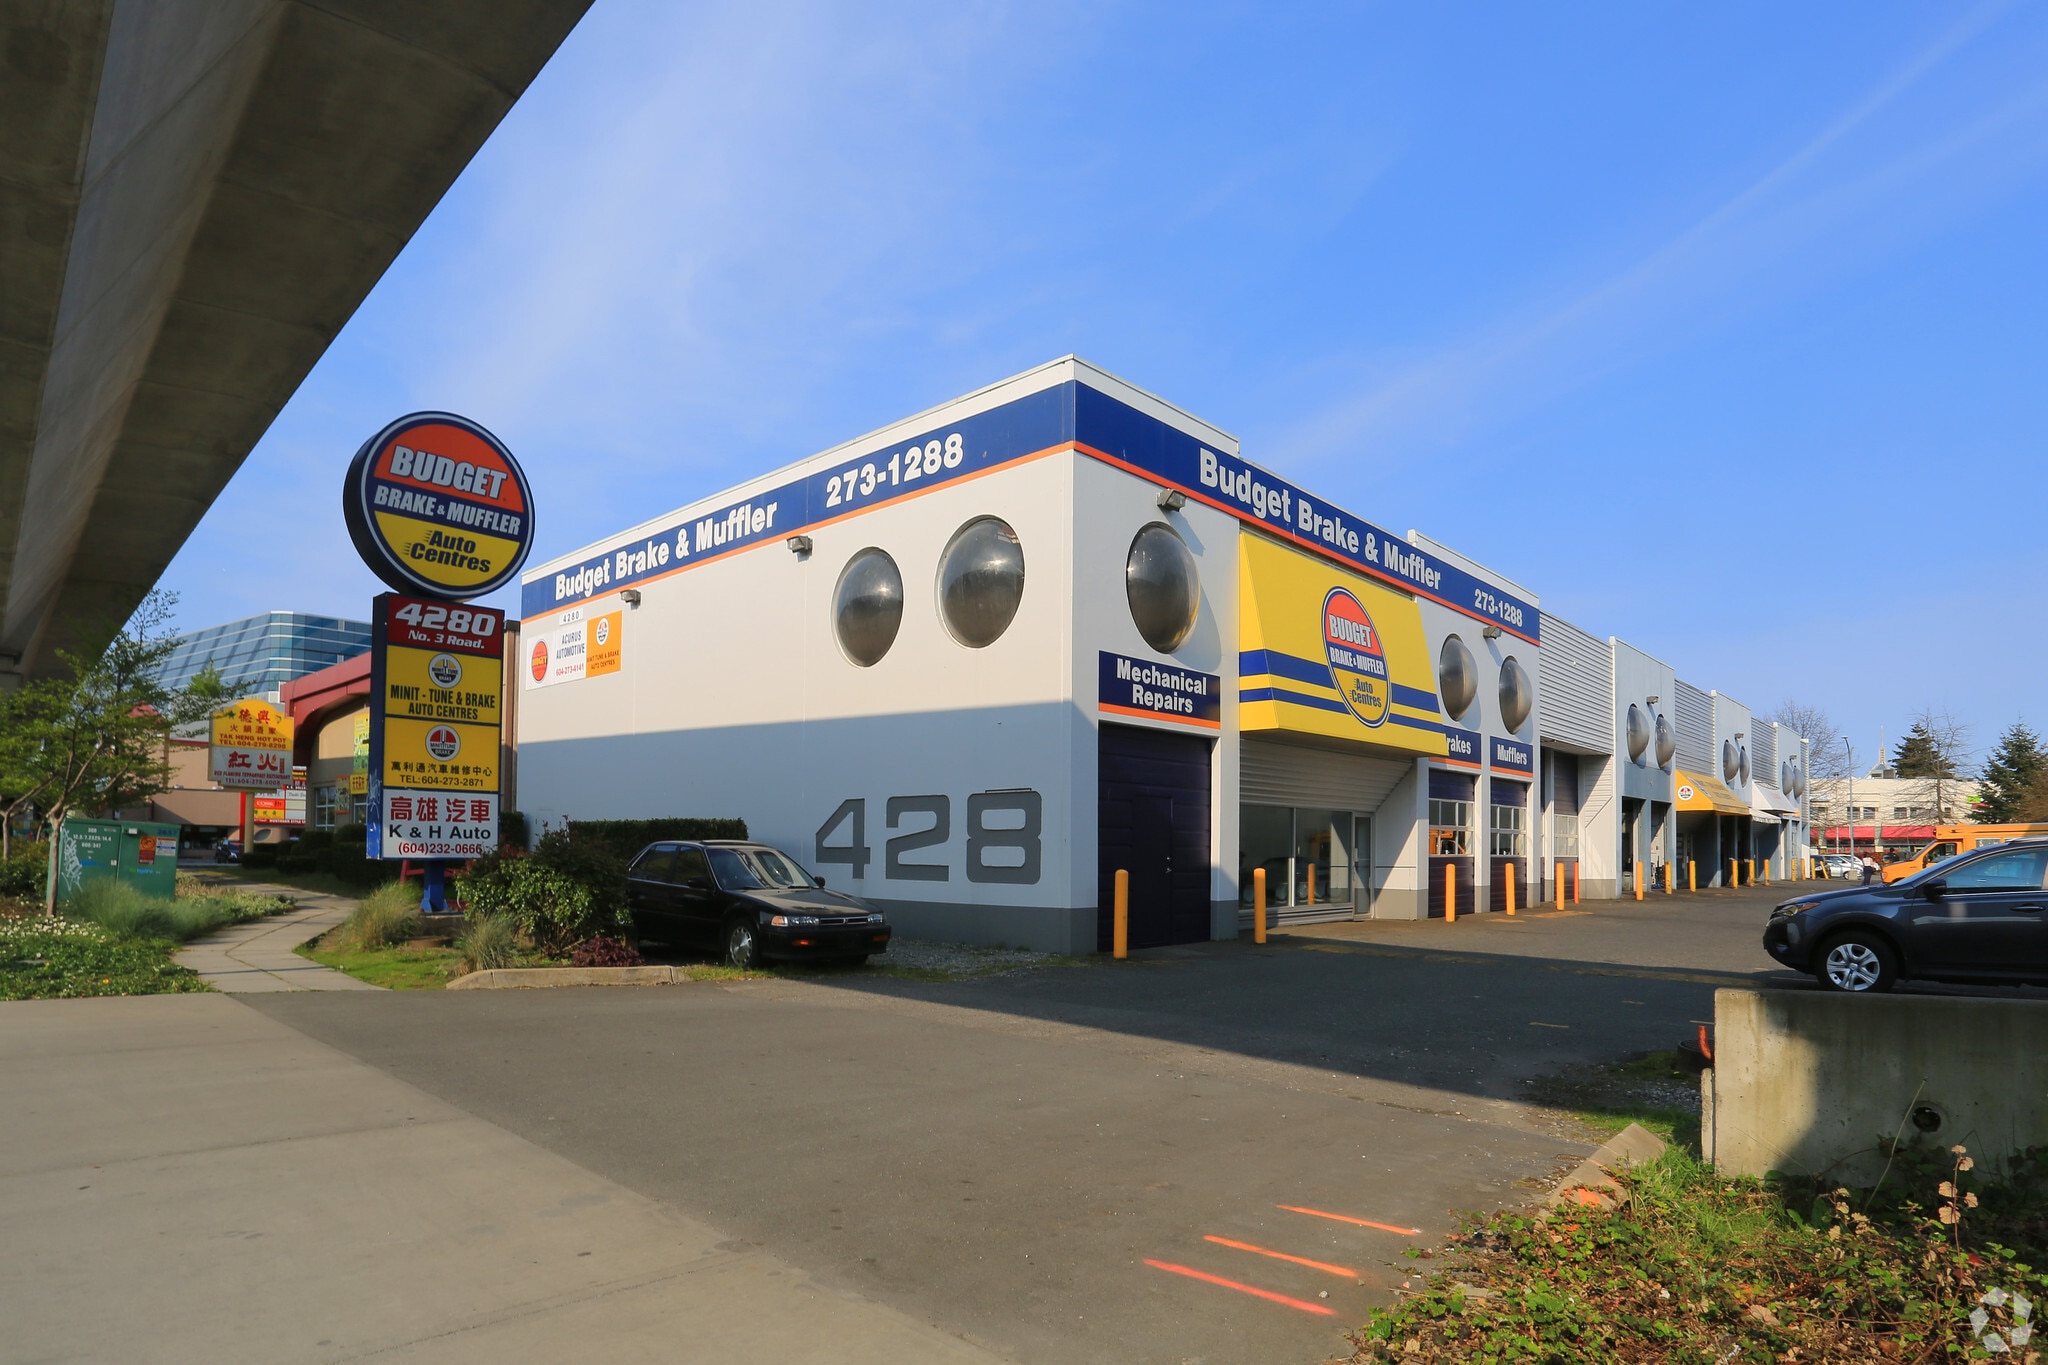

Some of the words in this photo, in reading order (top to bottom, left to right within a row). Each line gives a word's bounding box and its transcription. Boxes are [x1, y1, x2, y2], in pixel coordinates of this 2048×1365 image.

[389, 445, 507, 500] BUDGET
[826, 432, 964, 508] 273-1288
[374, 484, 437, 517] BRAKE
[437, 504, 445, 516] &
[446, 501, 521, 536] MUFFLER
[1199, 447, 1292, 523] Budget
[1298, 498, 1360, 554] Brake
[1364, 532, 1379, 564] &
[1384, 540, 1441, 590] Muffler
[428, 530, 477, 554] Auto
[555, 557, 610, 601] Budget
[615, 540, 669, 580] Brake
[675, 528, 690, 560] &
[695, 501, 778, 553] Muffler
[410, 542, 491, 573] Centres
[395, 602, 496, 637] 4280
[563, 611, 580, 622] 4280
[1474, 588, 1523, 627] 273-1288
[408, 629, 431, 642] No.
[434, 633, 444, 644] 3
[446, 635, 485, 649] Road.
[1328, 613, 1373, 649] BUDGET
[556, 643, 585, 660] AUTOMOTIVE
[1329, 646, 1353, 668] BRAKE
[1356, 653, 1385, 676] MUFFLER
[1116, 657, 1207, 696] Mechanical
[1356, 678, 1373, 694] Auto
[390, 684, 420, 701] MINIT
[429, 688, 453, 705] TUNE
[456, 691, 463, 705] &
[465, 692, 496, 709] BRAKE
[1132, 683, 1194, 714] Repairs
[1351, 689, 1382, 708] Centres
[408, 702, 434, 716] AUTO
[436, 705, 478, 720] CENTRES
[1446, 734, 1471, 755] rakes
[1497, 743, 1527, 766] Mufflers
[390, 796, 490, 823] 高雄汽車
[389, 824, 402, 838] K
[409, 826, 422, 838] &
[429, 825, 442, 839] H
[449, 826, 491, 840] Auto
[815, 790, 1042, 885] 428
[398, 842, 483, 855] (604)232-0666
